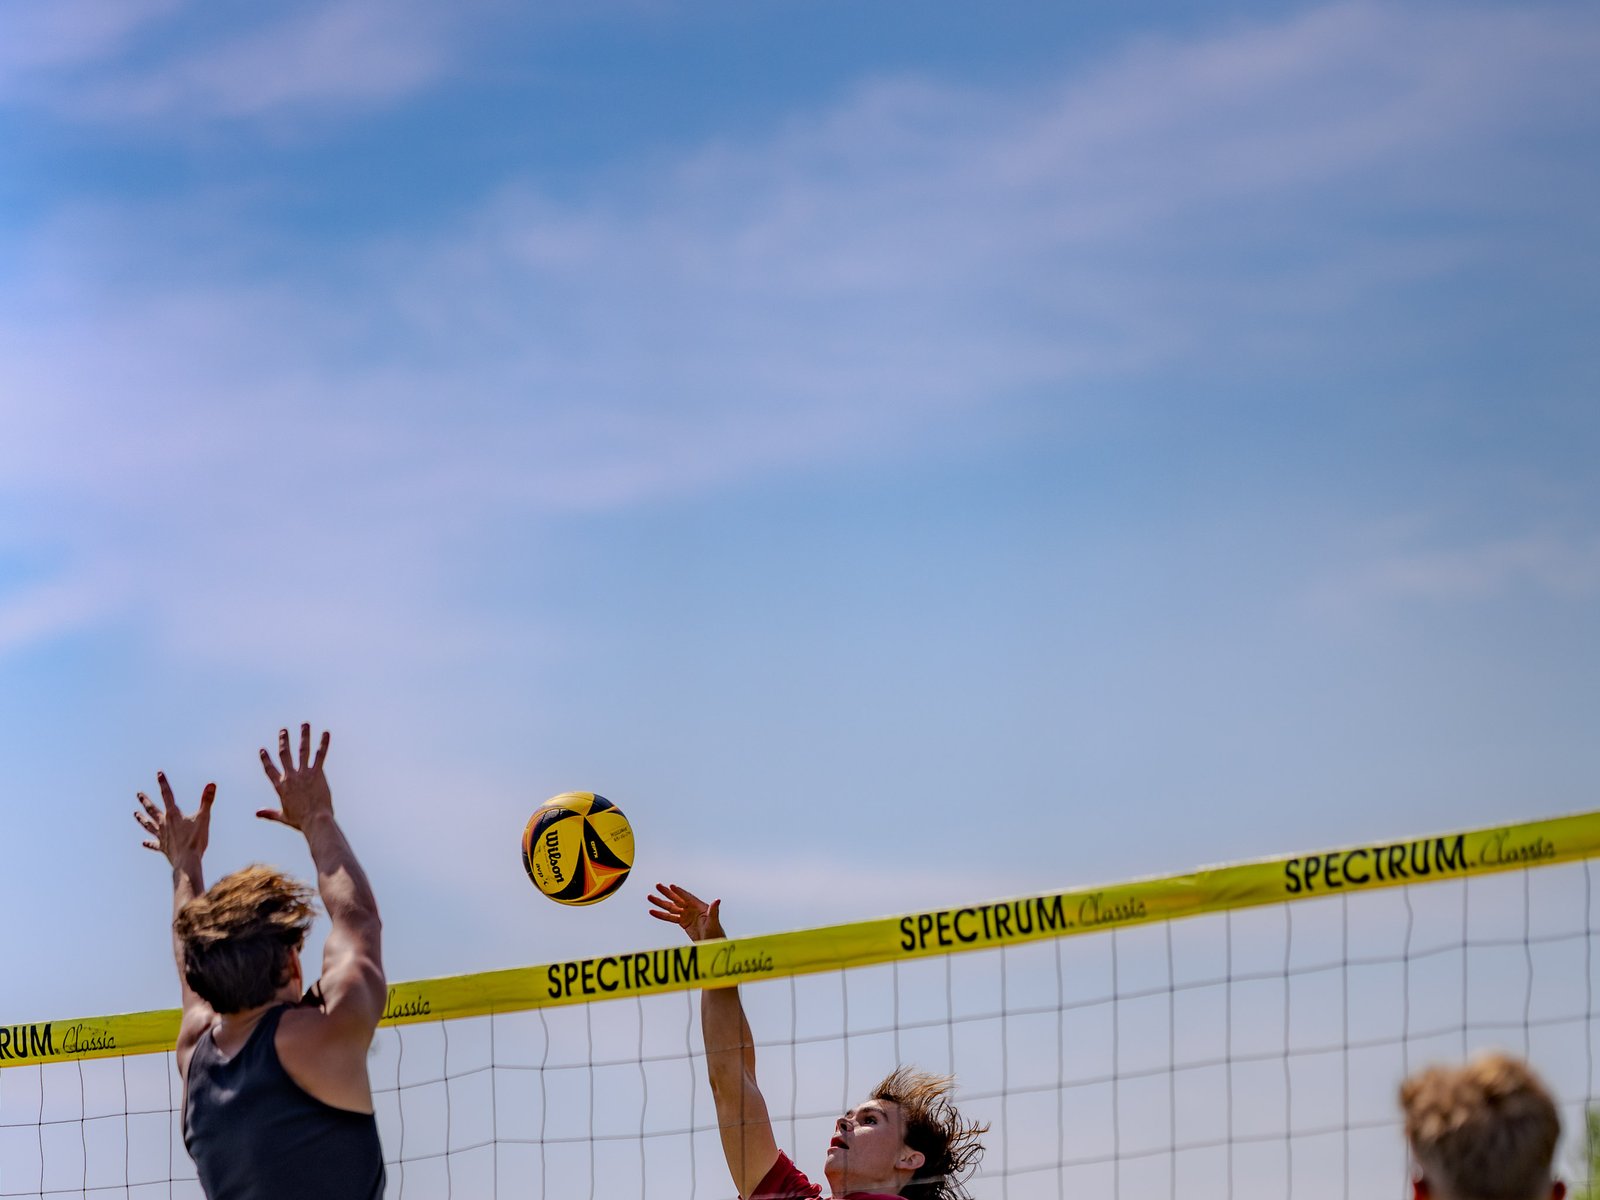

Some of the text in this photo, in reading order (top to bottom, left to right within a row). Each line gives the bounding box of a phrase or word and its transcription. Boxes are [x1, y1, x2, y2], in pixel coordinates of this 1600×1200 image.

[546, 830, 565, 883] Wilson
[1285, 829, 1556, 893] SPECTRUM Classic
[900, 893, 1148, 951] SPECTRUM Classic
[548, 944, 775, 998] SPECTRUM Classic
[382, 988, 431, 1019] lassic
[63, 1023, 116, 1053] Classic
